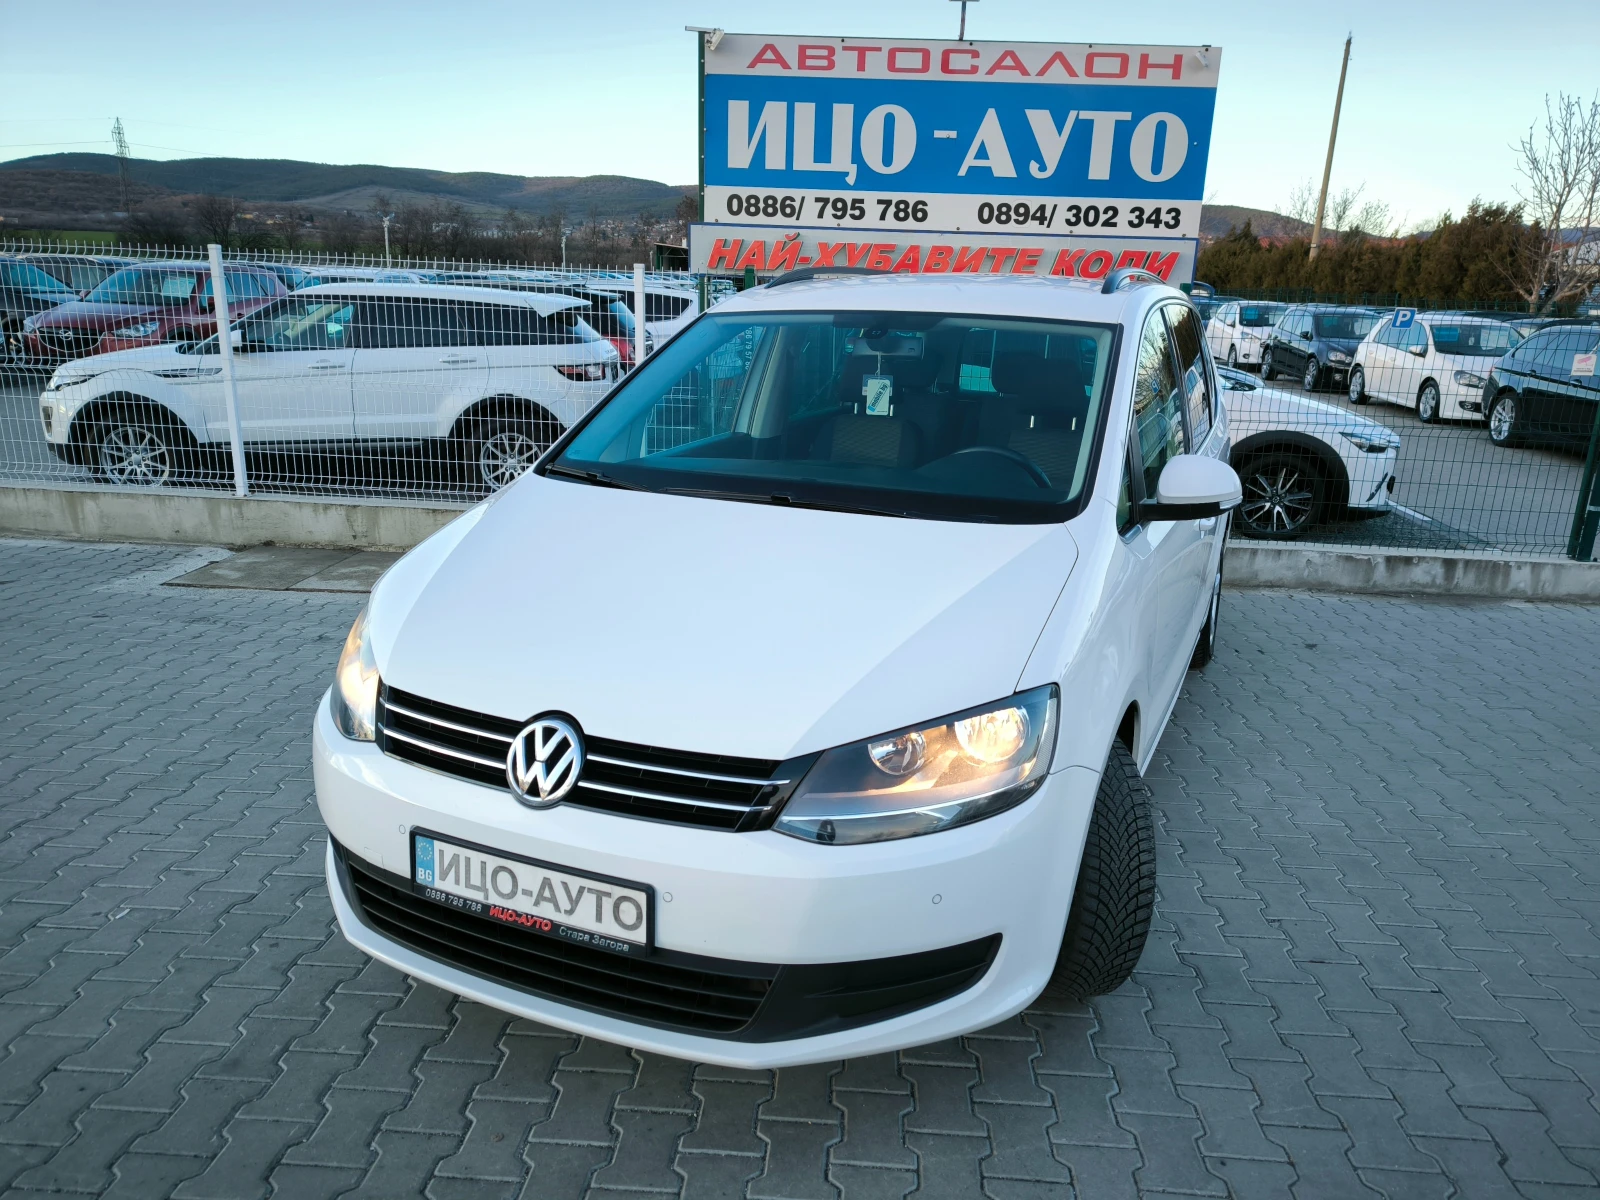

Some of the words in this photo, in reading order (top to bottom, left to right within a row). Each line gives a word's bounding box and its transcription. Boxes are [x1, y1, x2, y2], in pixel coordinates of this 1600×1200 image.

[746, 43, 1183, 81] АВТОСАЛОН
[726, 193, 806, 221] 0886/
[814, 196, 866, 222] 795
[876, 198, 929, 223] 786
[977, 201, 1058, 228] 0894/
[1064, 203, 1119, 229] 302
[1126, 206, 1181, 230] 343
[706, 231, 1045, 275] НАЙ-ХУБАВИТЕ
[1395, 310, 1412, 327] P
[418, 867, 433, 882] BG
[425, 888, 446, 902] 0886
[448, 895, 465, 907] 795
[466, 900, 483, 913] 786
[438, 848, 644, 932] ИЦО-АУТО
[489, 905, 552, 932] ИЦО-АУТО
[559, 926, 590, 943] Стара
[592, 932, 630, 952] Загора
